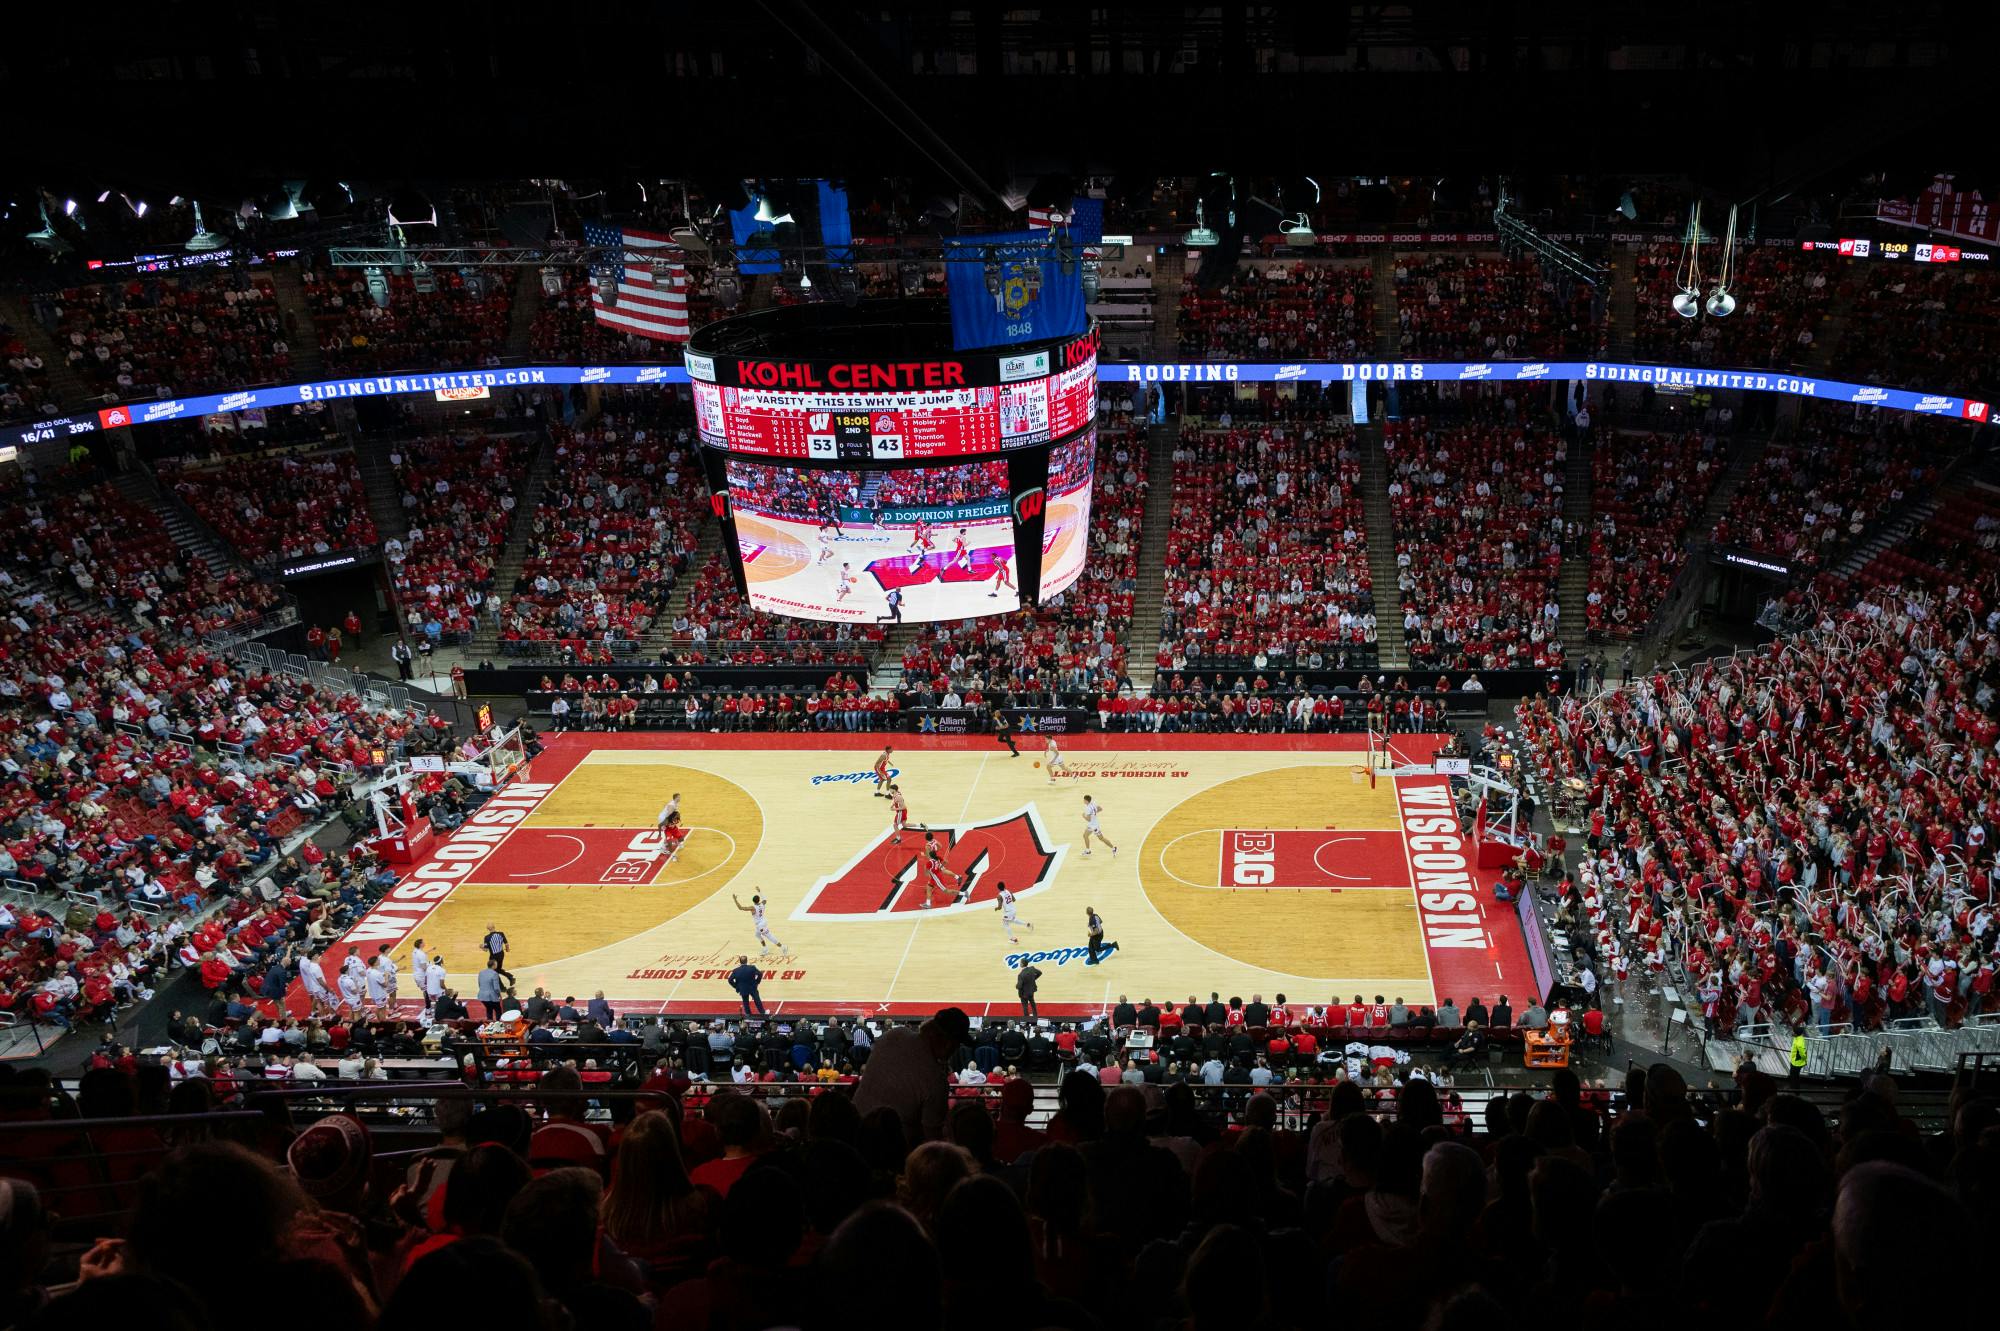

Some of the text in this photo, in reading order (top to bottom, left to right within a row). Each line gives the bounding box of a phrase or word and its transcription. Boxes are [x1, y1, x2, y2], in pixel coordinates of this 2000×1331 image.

[1322, 233, 1348, 243] 1947
[1356, 233, 1385, 243] 2000
[1430, 233, 1458, 242] 2014
[1467, 232, 1494, 242] 2015
[1611, 233, 1642, 242] FOUR
[1815, 242, 1839, 250] TOYOTA
[1856, 244, 1868, 253] 53
[1879, 242, 1909, 253] 18:08
[1917, 248, 1931, 258] 43
[1961, 253, 1990, 261] TOYOTA
[1006, 321, 1033, 337] 1848
[585, 368, 605, 376] Siding
[640, 367, 661, 376] Siding
[1128, 364, 1239, 381] ROOFING
[1279, 364, 1301, 375] Siding
[1342, 363, 1424, 380] DOORS
[1459, 368, 1492, 379] Unlimited
[1465, 363, 1487, 373] Siding
[1516, 368, 1549, 379] Unlimited
[1523, 363, 1544, 373] Siding
[580, 372, 611, 383] Unlimited
[636, 371, 667, 382] Unlimited
[738, 361, 966, 388] KOHL CENTER
[1274, 368, 1307, 380] Unlimited
[1858, 387, 1882, 395] Siding
[222, 391, 249, 404] Siding
[757, 396, 805, 405] VARSITY
[815, 398, 845, 406] THIS
[848, 398, 862, 406] IS
[865, 398, 893, 406] WHY
[897, 398, 916, 406] WE
[920, 396, 954, 405] JUMP
[1029, 395, 1045, 403] THIS
[1852, 393, 1888, 402] Unlimited
[149, 400, 176, 413] Siding
[218, 395, 257, 412] Unlimited
[1914, 402, 1953, 411] Unlimited
[144, 403, 184, 421] Unlimited
[1029, 409, 1044, 417] WHY
[33, 418, 72, 430] FIELD GOAL
[809, 413, 829, 432] W
[836, 416, 870, 426] 18:08
[1031, 421, 1048, 431] JUMP
[69, 421, 94, 434] 39%
[21, 429, 55, 444] 16/41
[813, 440, 832, 451] 53
[878, 440, 899, 451] 43
[914, 441, 946, 449] Njegovan
[1002, 440, 1027, 448] STUDENT
[1019, 491, 1045, 521] W
[896, 509, 954, 521] DOMINION
[958, 504, 1009, 518] FREIGHT
[295, 557, 356, 573] UNDER ARMOUR
[1736, 556, 1788, 573] UNDER ARMOUR
[752, 592, 867, 617] AB NICHOLAS COURT
[939, 716, 966, 725] Alliant
[1039, 715, 1067, 725] Alliant
[939, 725, 966, 733] Energy
[1039, 724, 1066, 733] Energy
[343, 783, 555, 943] WISCONSIN
[1400, 785, 1486, 949] WISCONSIN
[1004, 895, 1012, 904] 25
[626, 969, 688, 980] COURT
[781, 970, 806, 980] AB
[1375, 1010, 1385, 1018] 55
